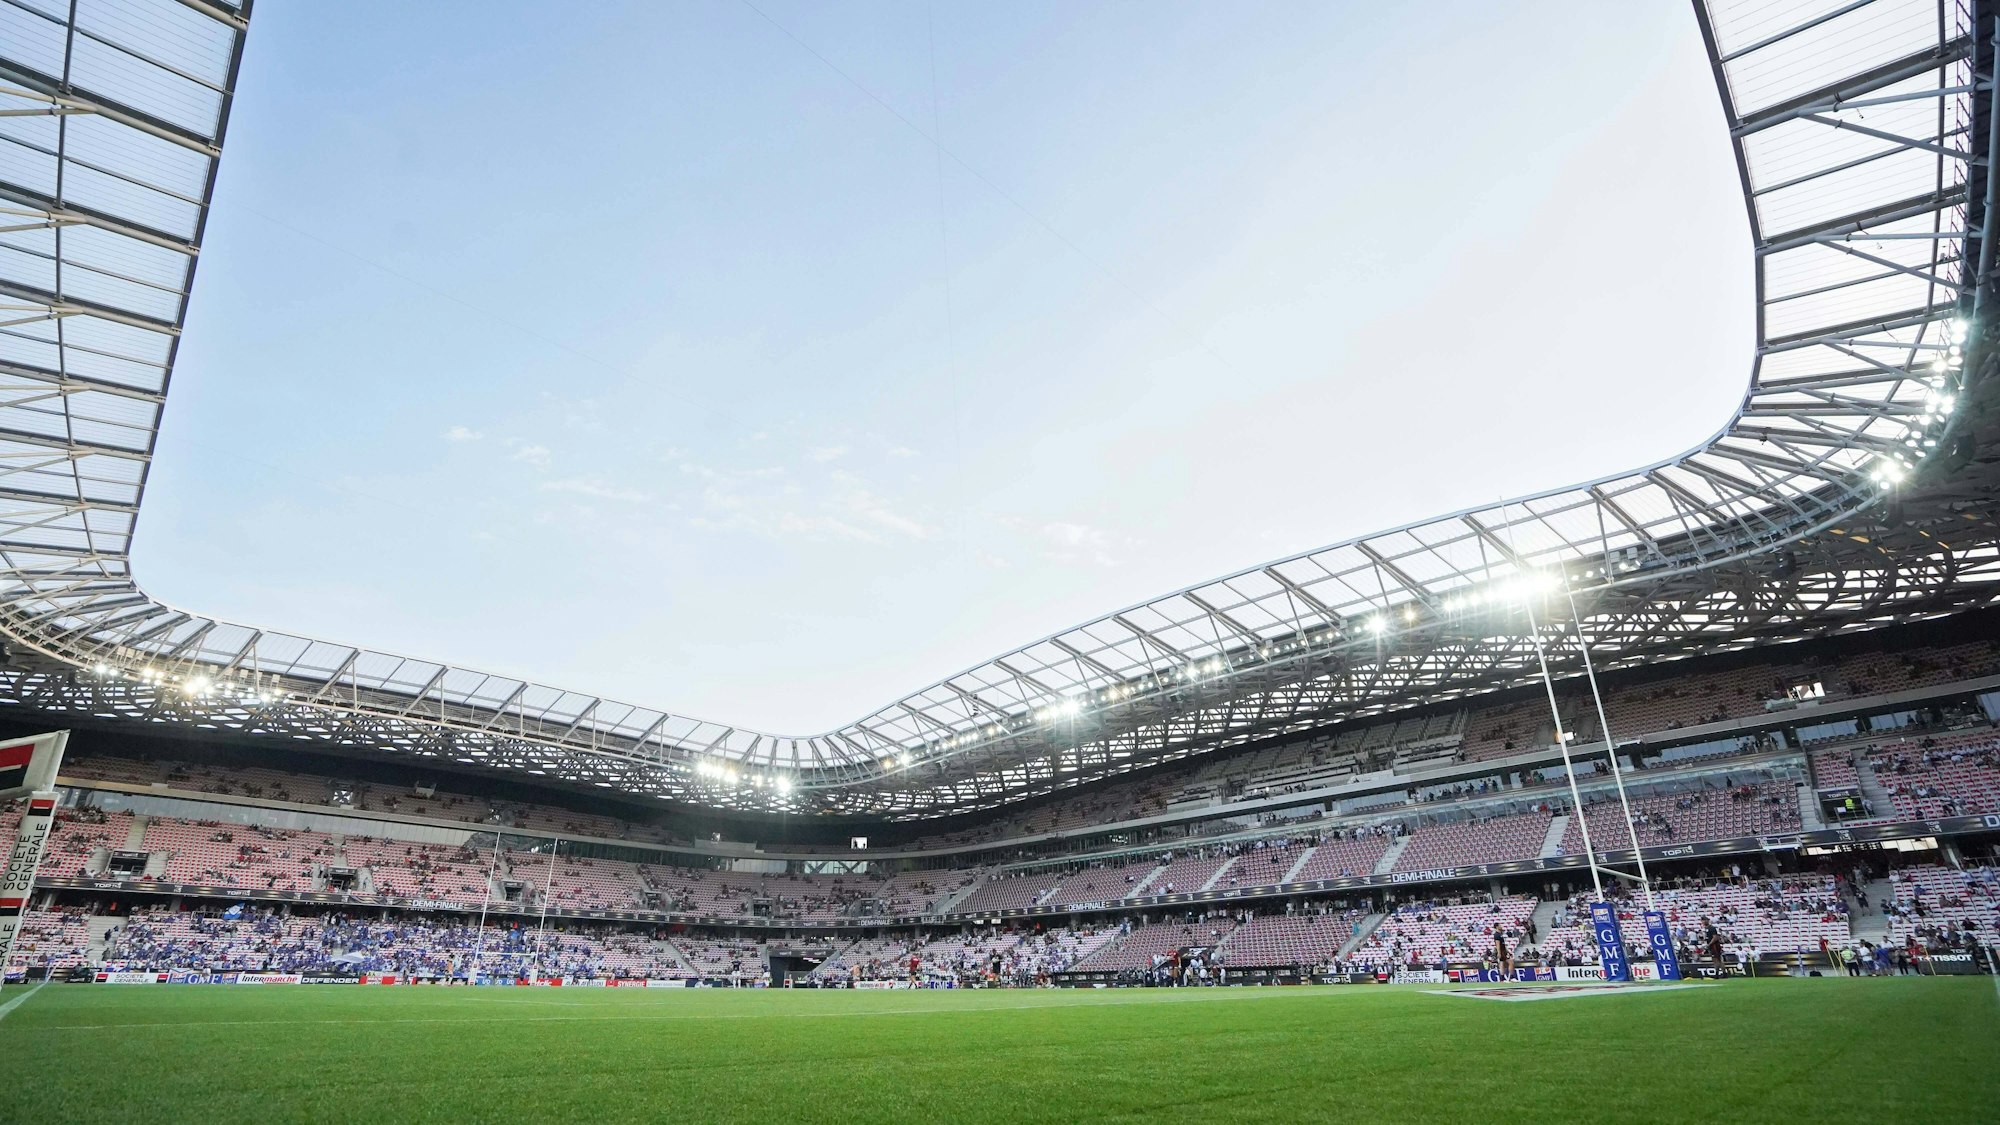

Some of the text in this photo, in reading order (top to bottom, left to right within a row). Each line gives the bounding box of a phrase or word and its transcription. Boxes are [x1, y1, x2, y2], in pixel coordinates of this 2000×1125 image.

[17, 823, 48, 891] GENERALE
[1661, 845, 1694, 857] TOP14
[3, 835, 31, 890] SOCIETE
[1392, 868, 1457, 883] DEMI-FINALE
[412, 899, 465, 910] DEMI-FINALE
[1068, 901, 1106, 912] DEMI-FINALE
[860, 918, 891, 926] DEMI-FINALE
[1601, 929, 1620, 976] GMF
[1654, 934, 1672, 976] GMF
[617, 980, 646, 988] SYNERGIE
